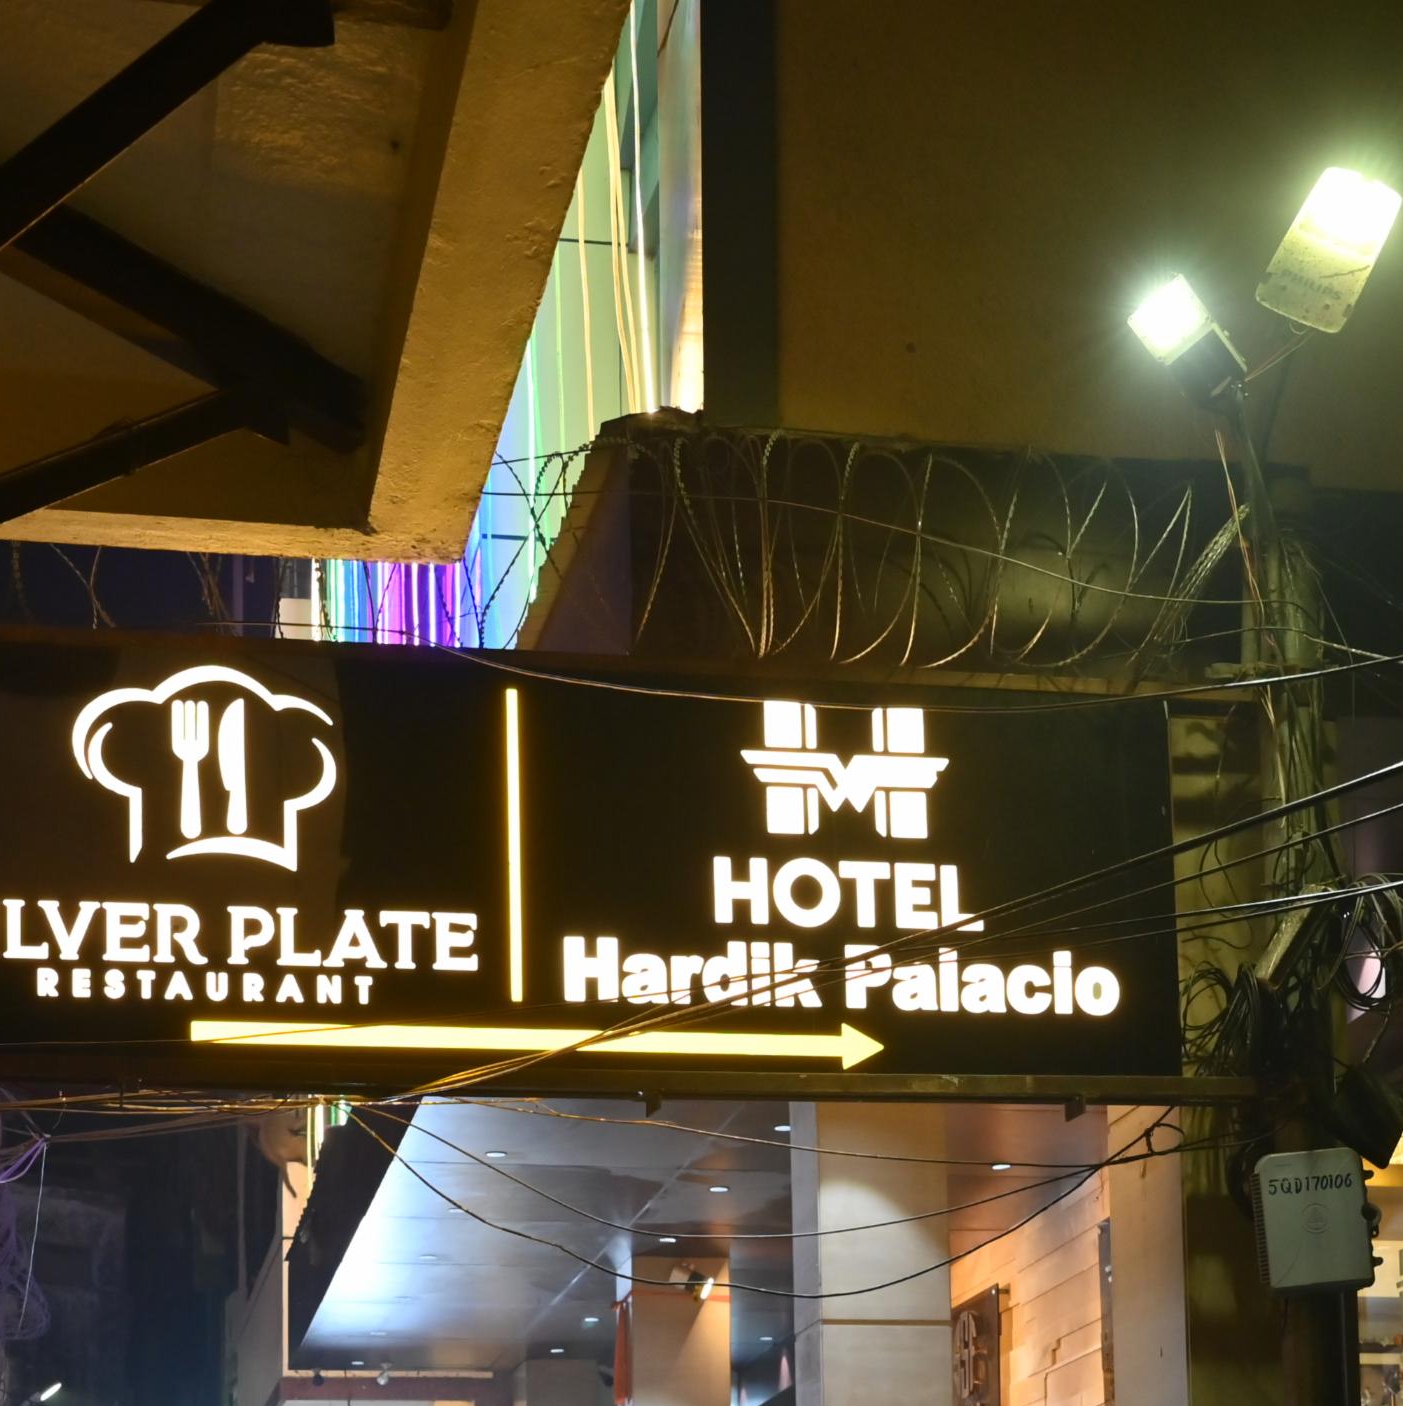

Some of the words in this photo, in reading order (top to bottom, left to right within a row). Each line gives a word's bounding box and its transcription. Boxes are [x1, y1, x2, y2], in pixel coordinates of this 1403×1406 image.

[713, 856, 984, 931] HOTEL
[227, 906, 478, 971] PLATE
[36, 968, 373, 1004] RESTAURANT
[563, 936, 823, 1007] Hardik
[844, 944, 1121, 1016] Palacio
